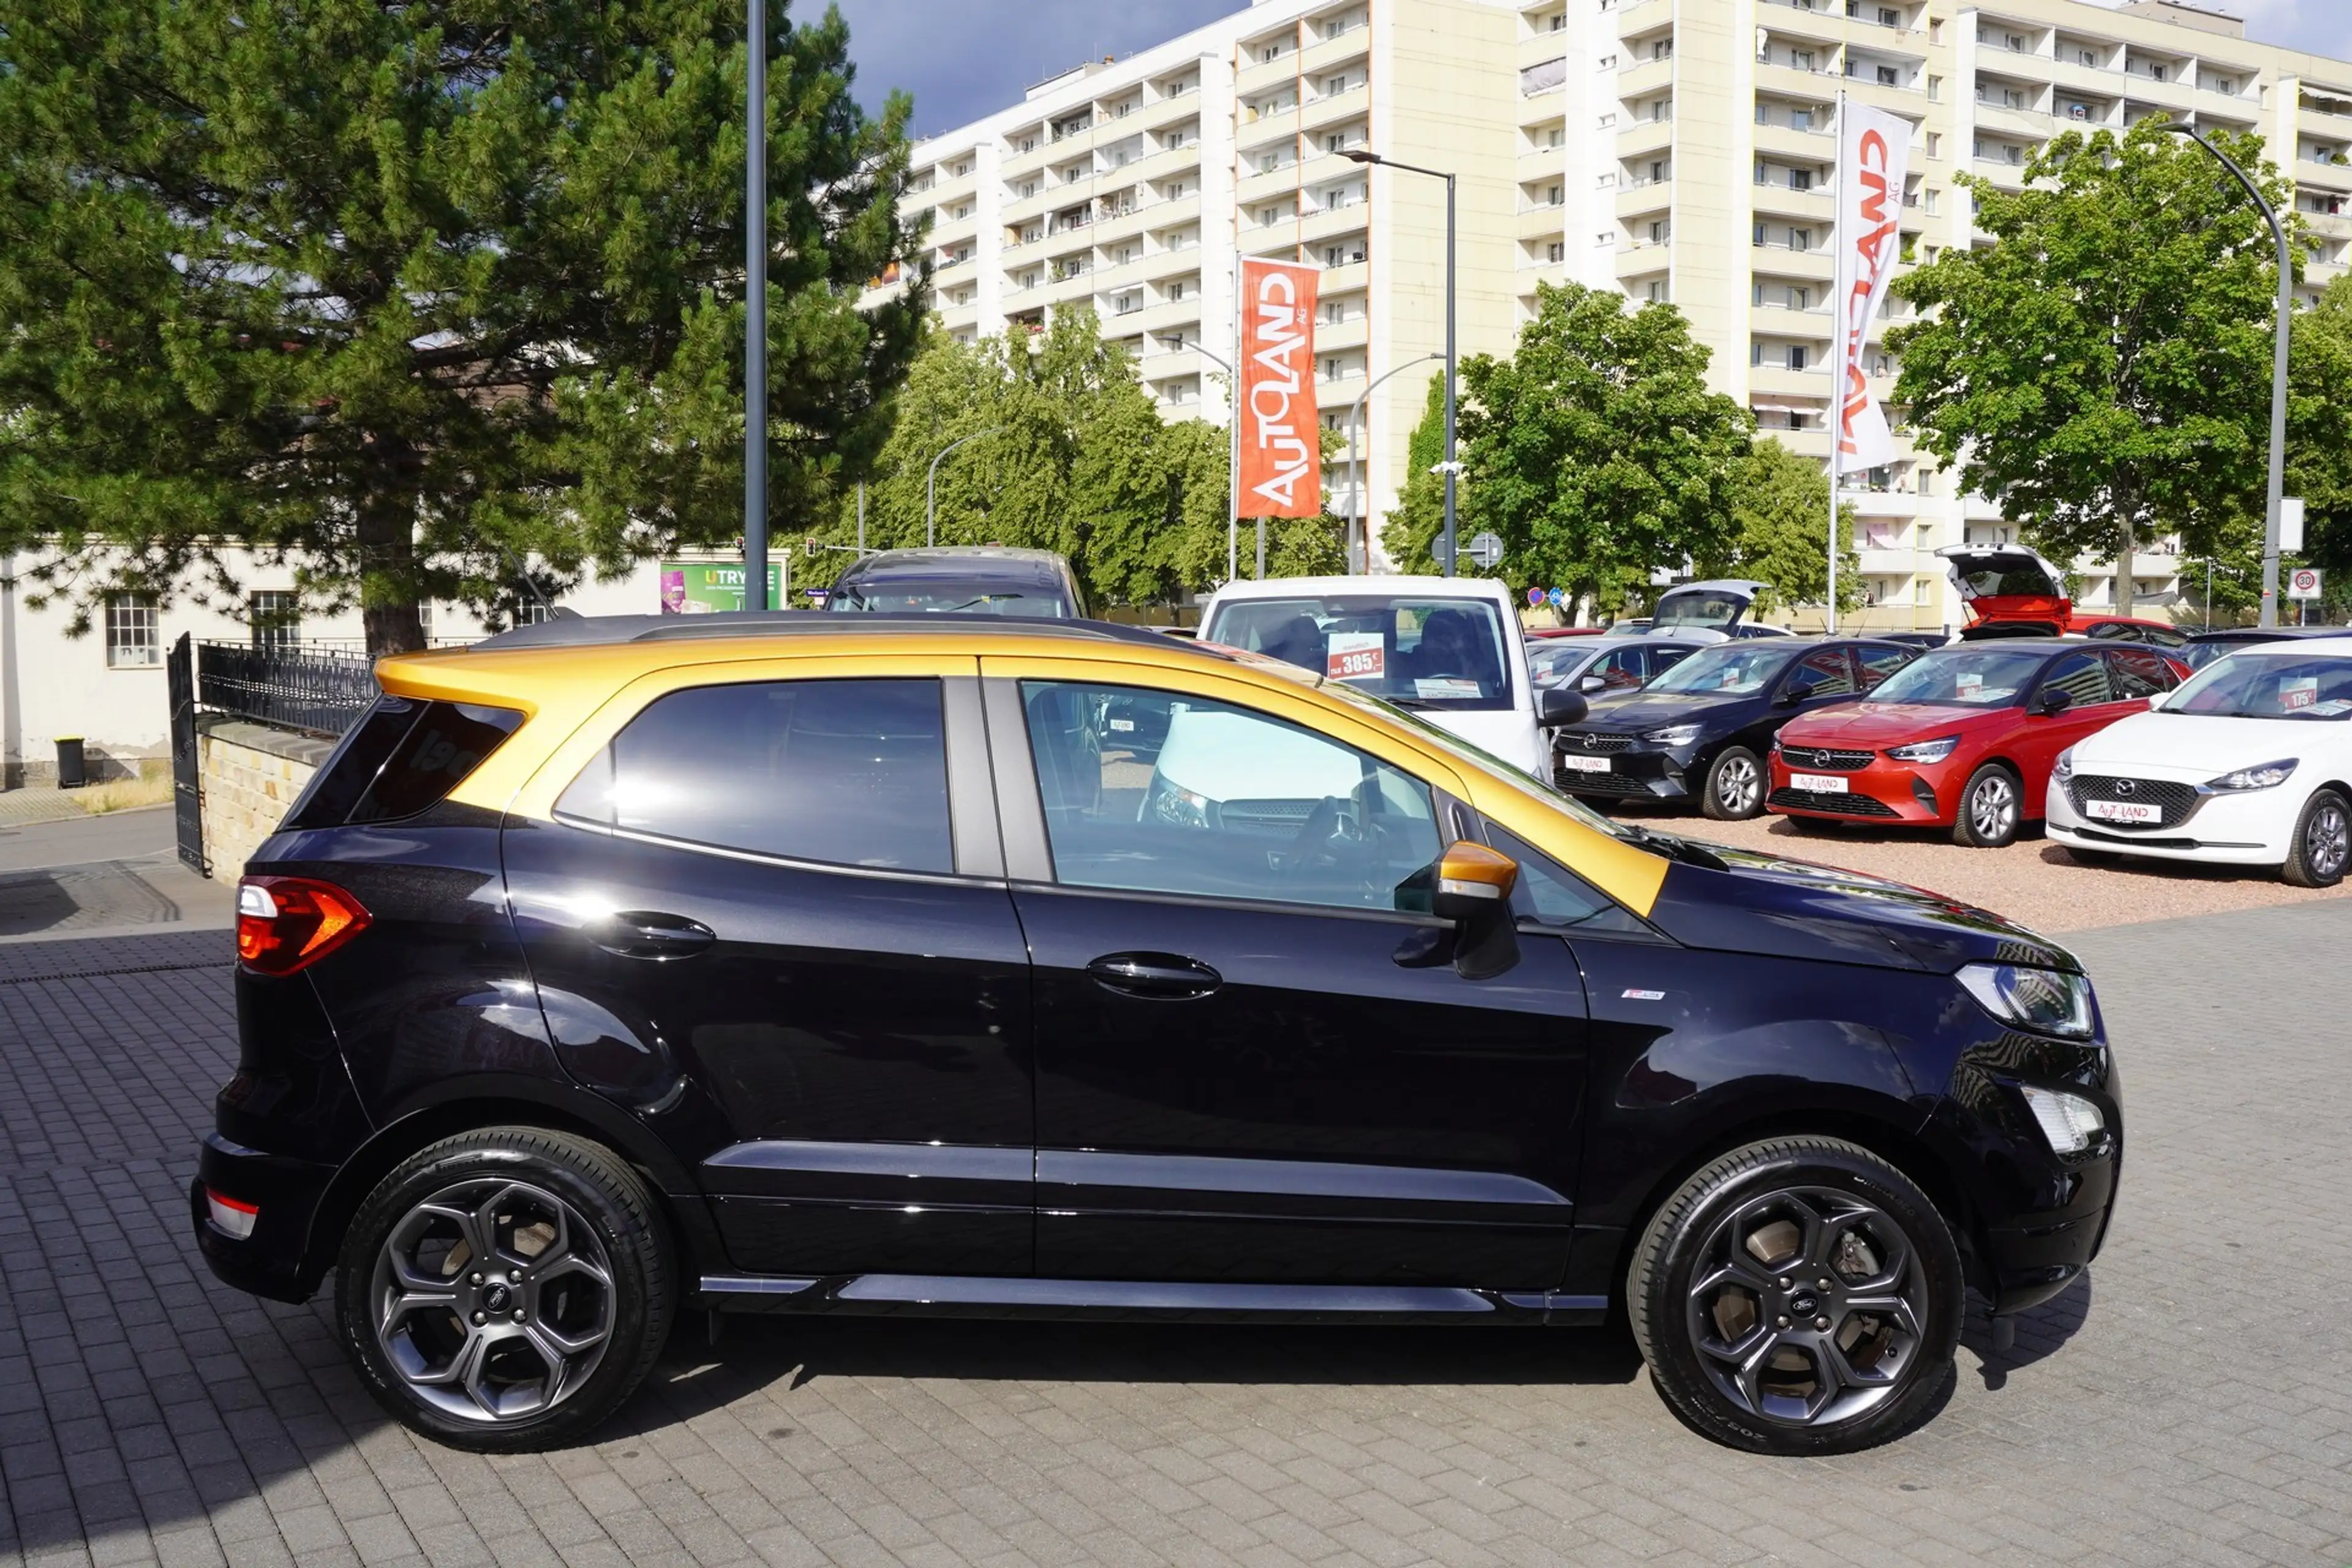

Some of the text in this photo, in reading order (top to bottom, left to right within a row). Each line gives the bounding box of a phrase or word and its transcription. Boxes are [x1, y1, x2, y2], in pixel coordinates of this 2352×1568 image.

[1887, 181, 1900, 205] AG
[1297, 308, 1307, 325] AG
[1250, 272, 1310, 508] AUTOLAND
[2299, 576, 2311, 585] 30
